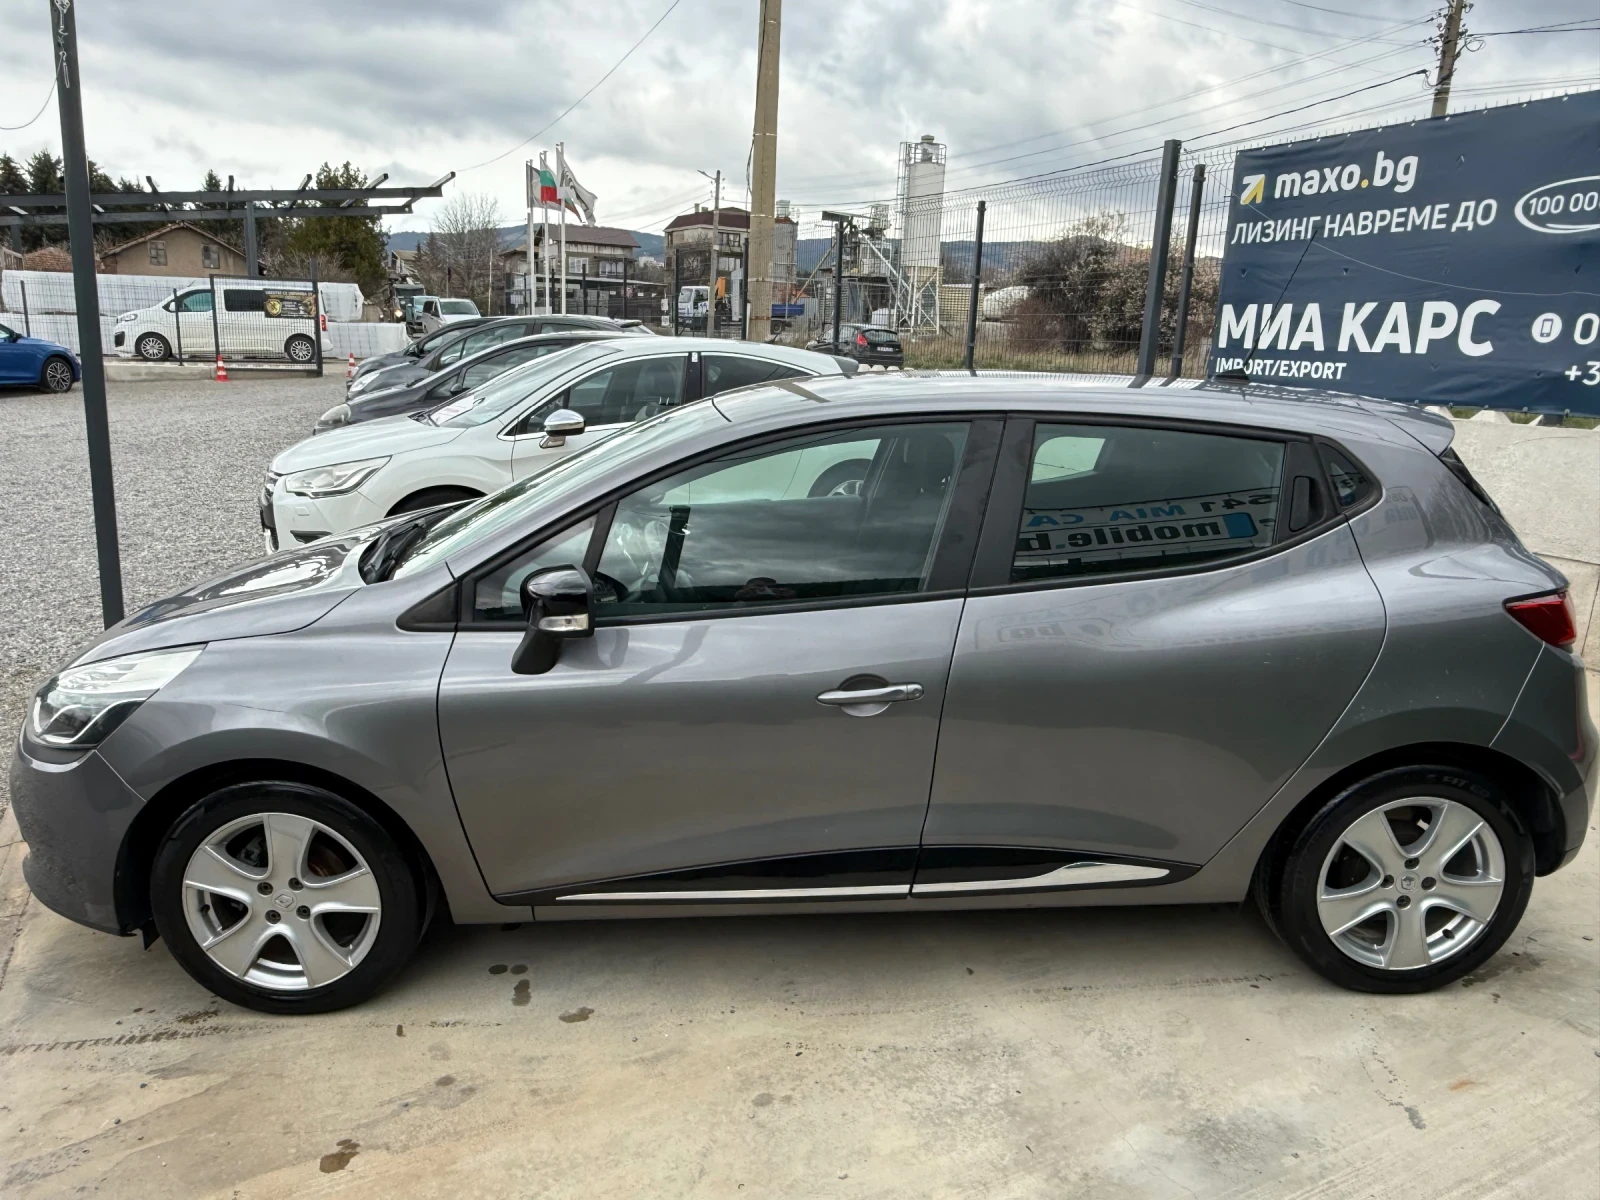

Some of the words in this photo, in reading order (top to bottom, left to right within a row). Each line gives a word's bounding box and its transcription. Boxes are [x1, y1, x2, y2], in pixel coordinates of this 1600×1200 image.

[1274, 150, 1419, 199] maxo.bg
[1231, 215, 1321, 245] ЛИЗИНГ
[1323, 203, 1450, 238] НАВРЕМЕ
[1451, 198, 1498, 233] ДО
[1529, 194, 1565, 216] 100
[1569, 191, 1600, 213] 00
[1218, 303, 1325, 351] МИА
[1337, 299, 1502, 357] КАРС
[1215, 357, 1348, 380] IMPORT/EXPORT
